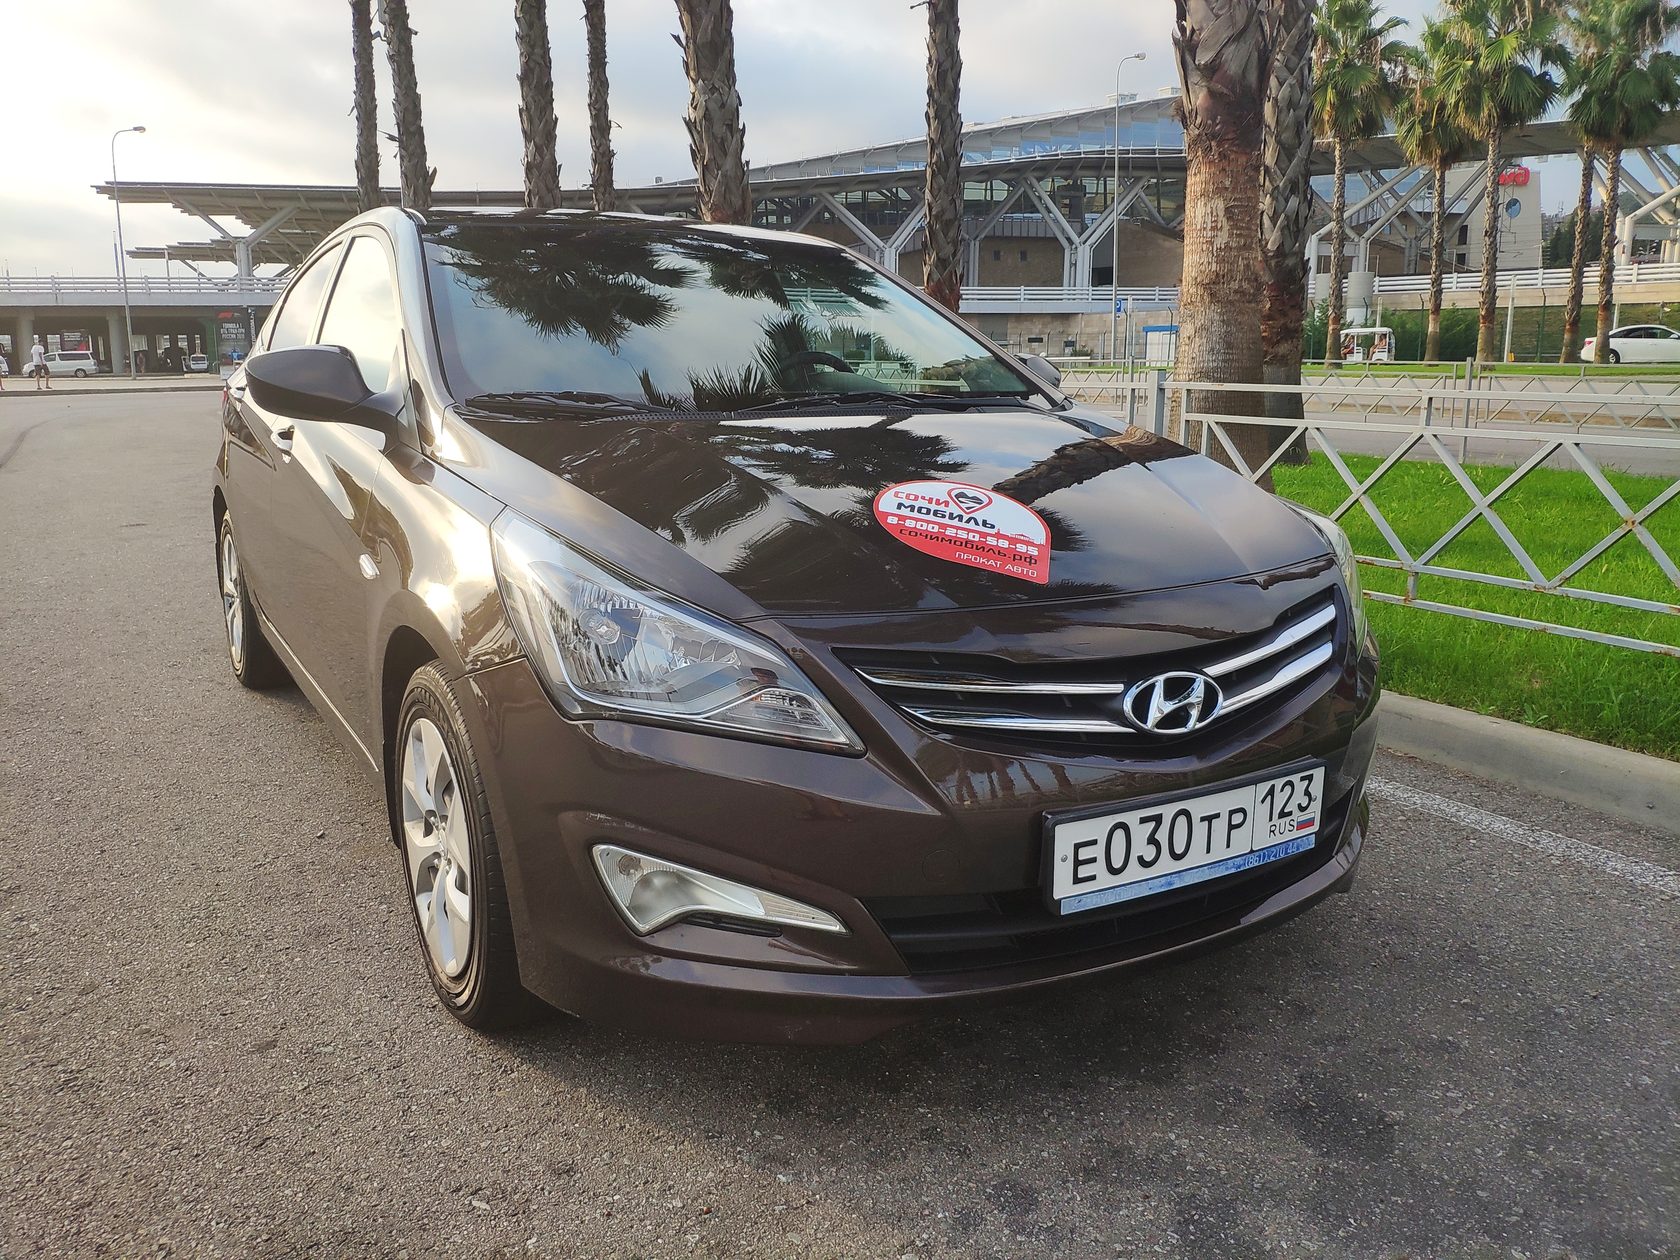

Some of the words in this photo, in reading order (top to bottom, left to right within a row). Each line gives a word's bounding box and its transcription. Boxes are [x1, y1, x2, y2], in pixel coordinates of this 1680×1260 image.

[893, 490, 950, 508] СОЧИ
[896, 502, 996, 530] МОБИЛЬ
[886, 516, 1039, 556] 8-800-250-58-95
[955, 551, 1003, 568] ПРОКАТ
[1004, 563, 1037, 577] АВТО
[1260, 773, 1314, 823] 123
[1268, 818, 1296, 839] RUS
